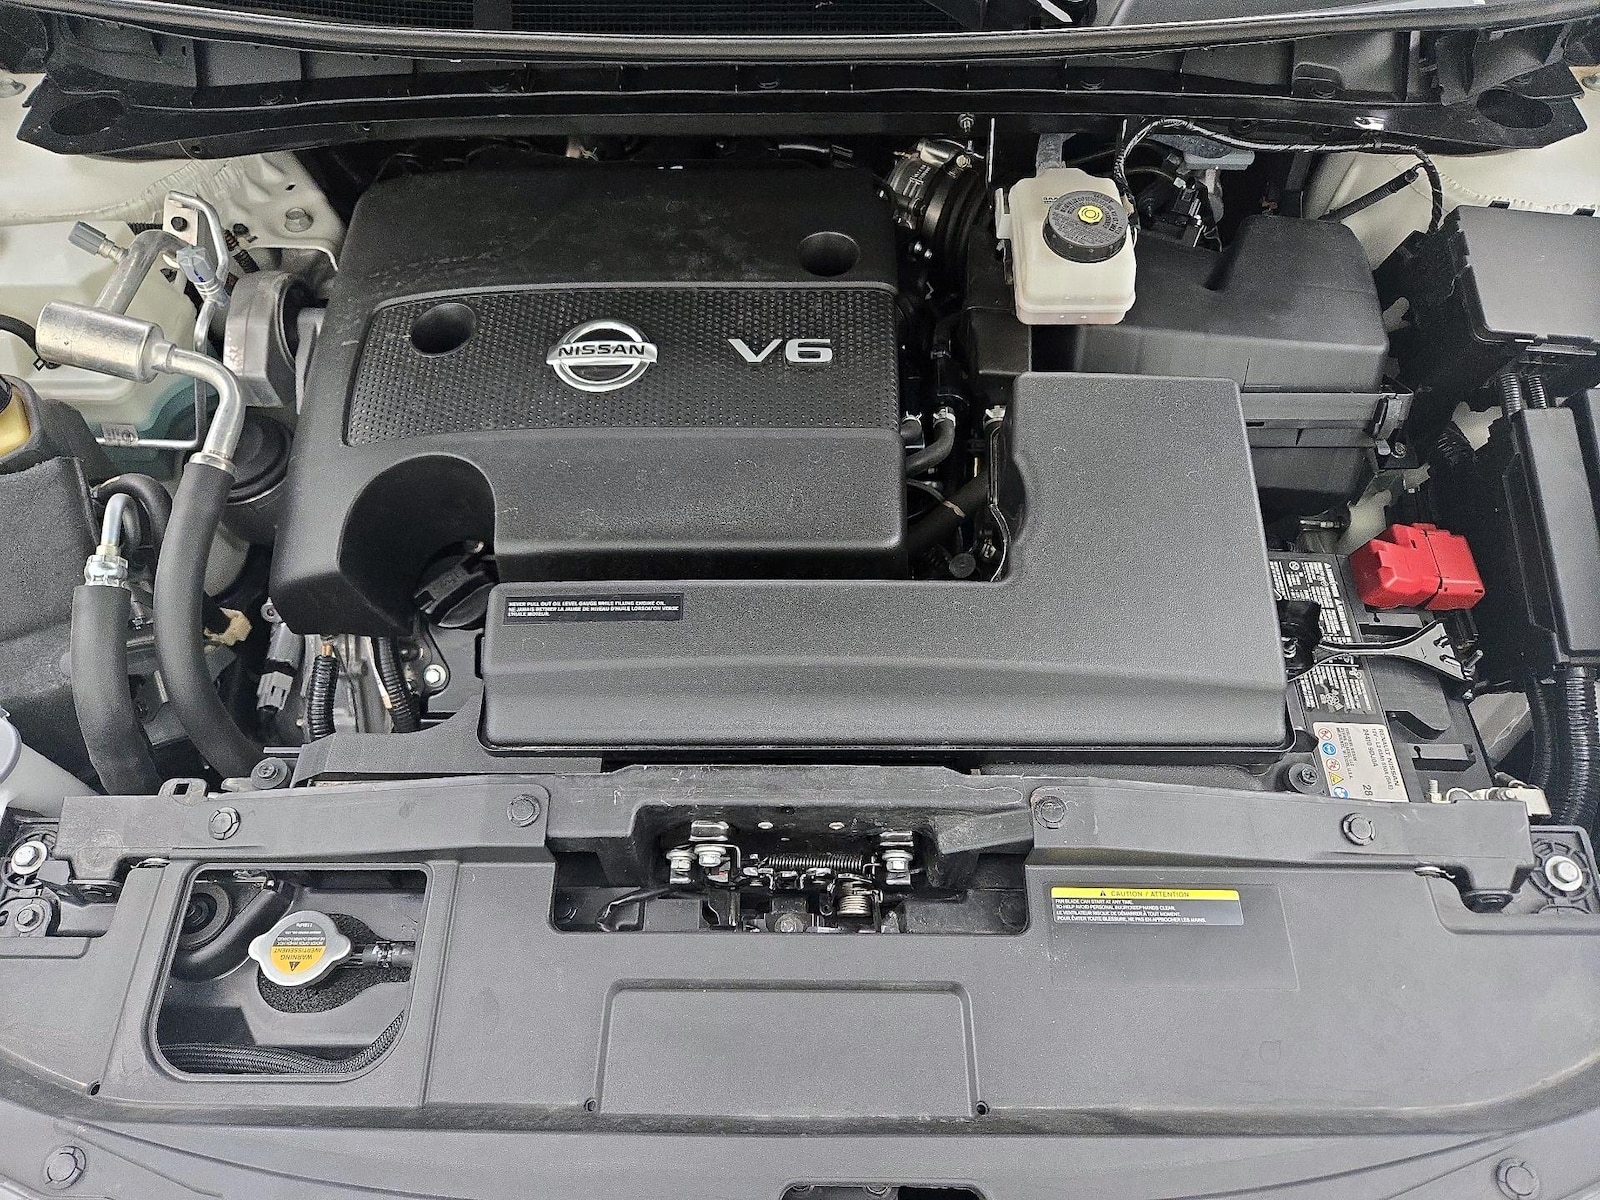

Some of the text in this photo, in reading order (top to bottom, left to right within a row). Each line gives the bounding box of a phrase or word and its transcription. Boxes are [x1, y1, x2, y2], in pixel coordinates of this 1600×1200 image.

[558, 344, 646, 356] NISSAN
[727, 338, 833, 363] V6
[1362, 728, 1373, 746] 24410
[1378, 728, 1399, 786] RENAULT NISSAN
[1362, 784, 1373, 796] 28
